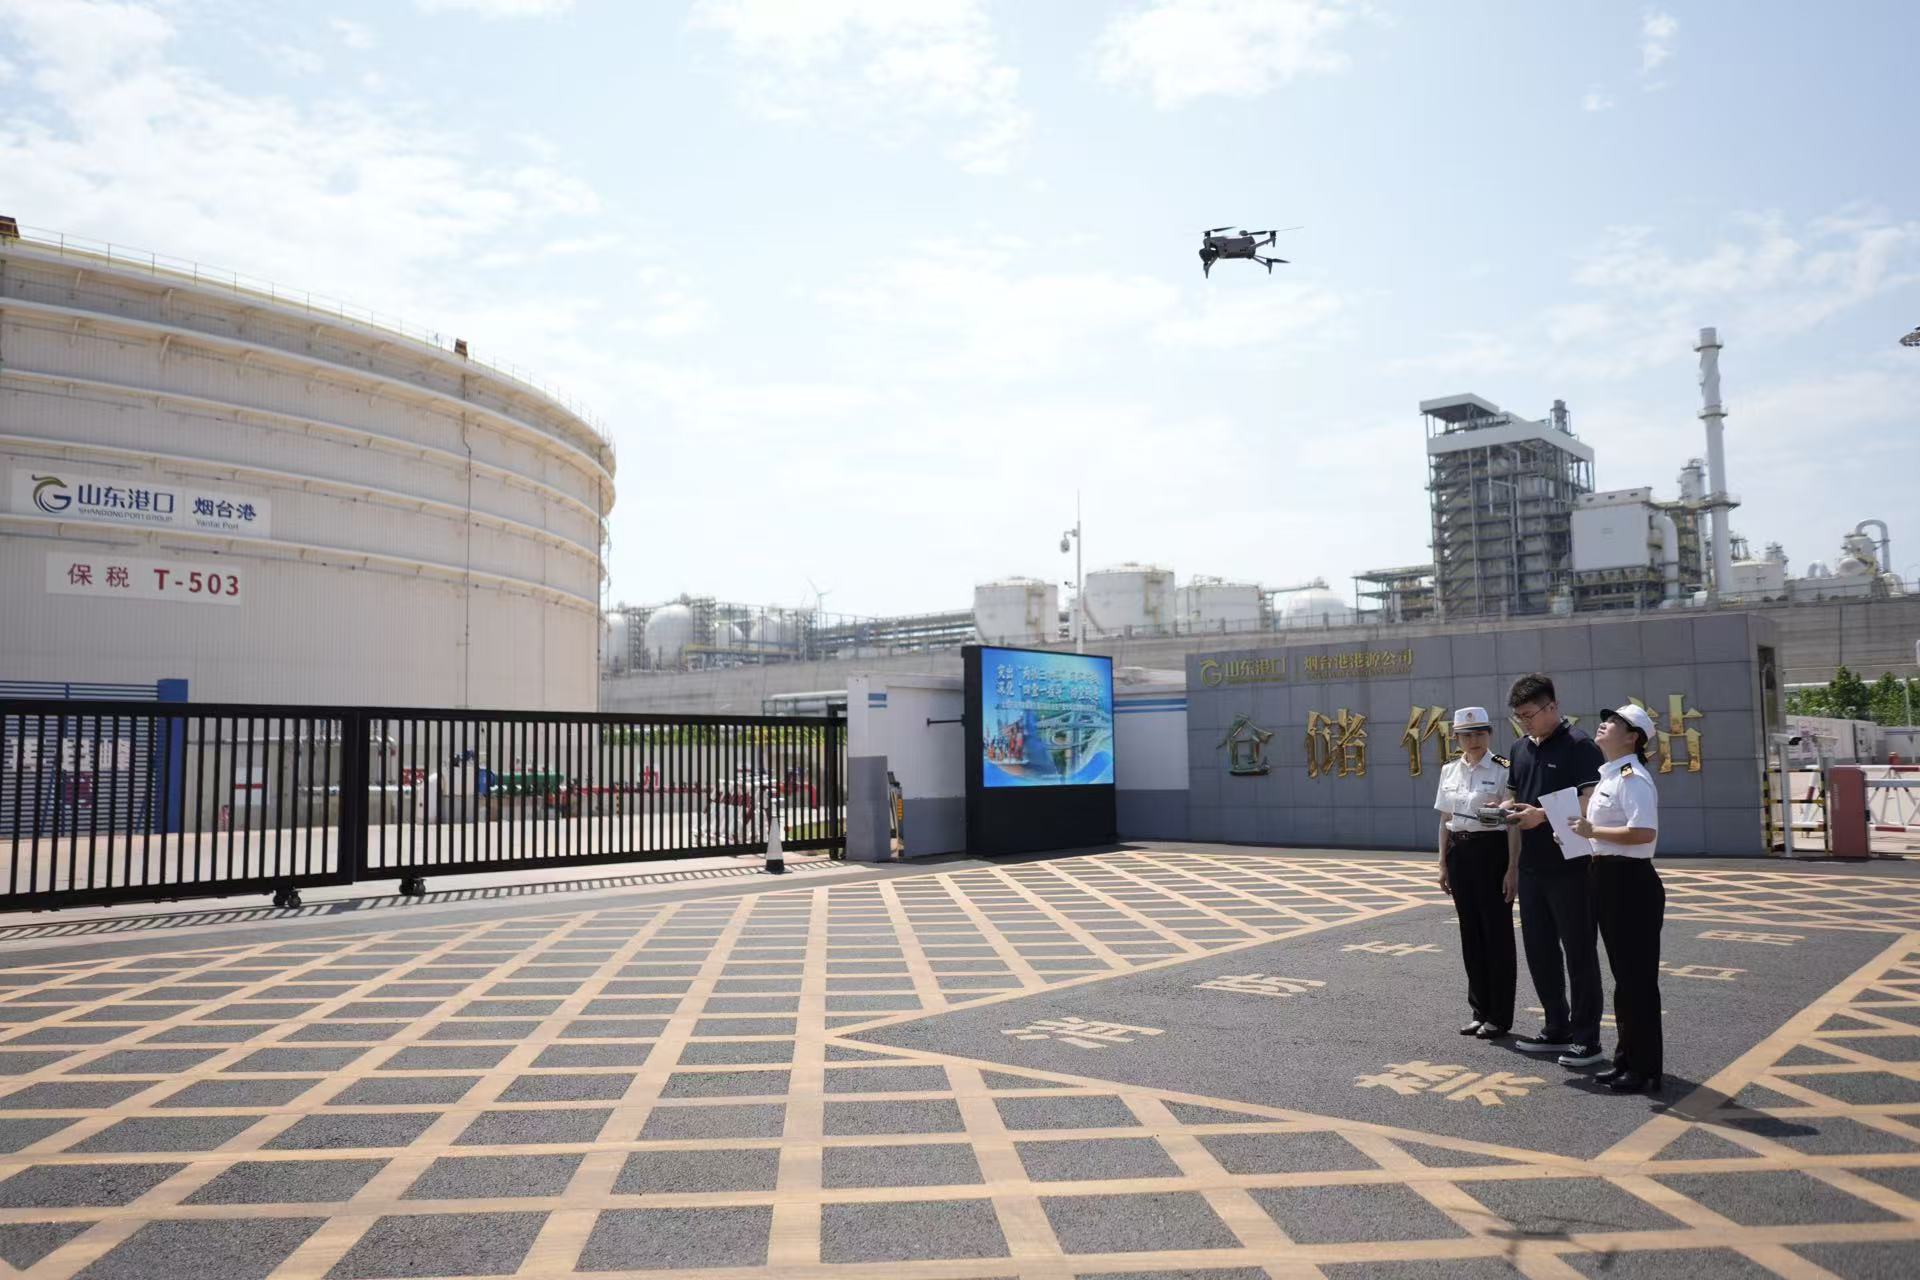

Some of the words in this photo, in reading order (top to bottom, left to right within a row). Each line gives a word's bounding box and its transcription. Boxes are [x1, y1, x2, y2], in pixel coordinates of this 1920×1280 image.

[78, 483, 174, 513] 山东港口
[192, 497, 257, 521] 烟台港
[78, 508, 123, 519] SHANDONG
[124, 513, 145, 521] PORT
[146, 514, 173, 522] GROUP
[195, 518, 220, 529] Yantai
[222, 521, 239, 530] Port
[67, 563, 130, 589] 保税
[153, 568, 239, 596] T-503
[1224, 656, 1287, 676] 山东港口
